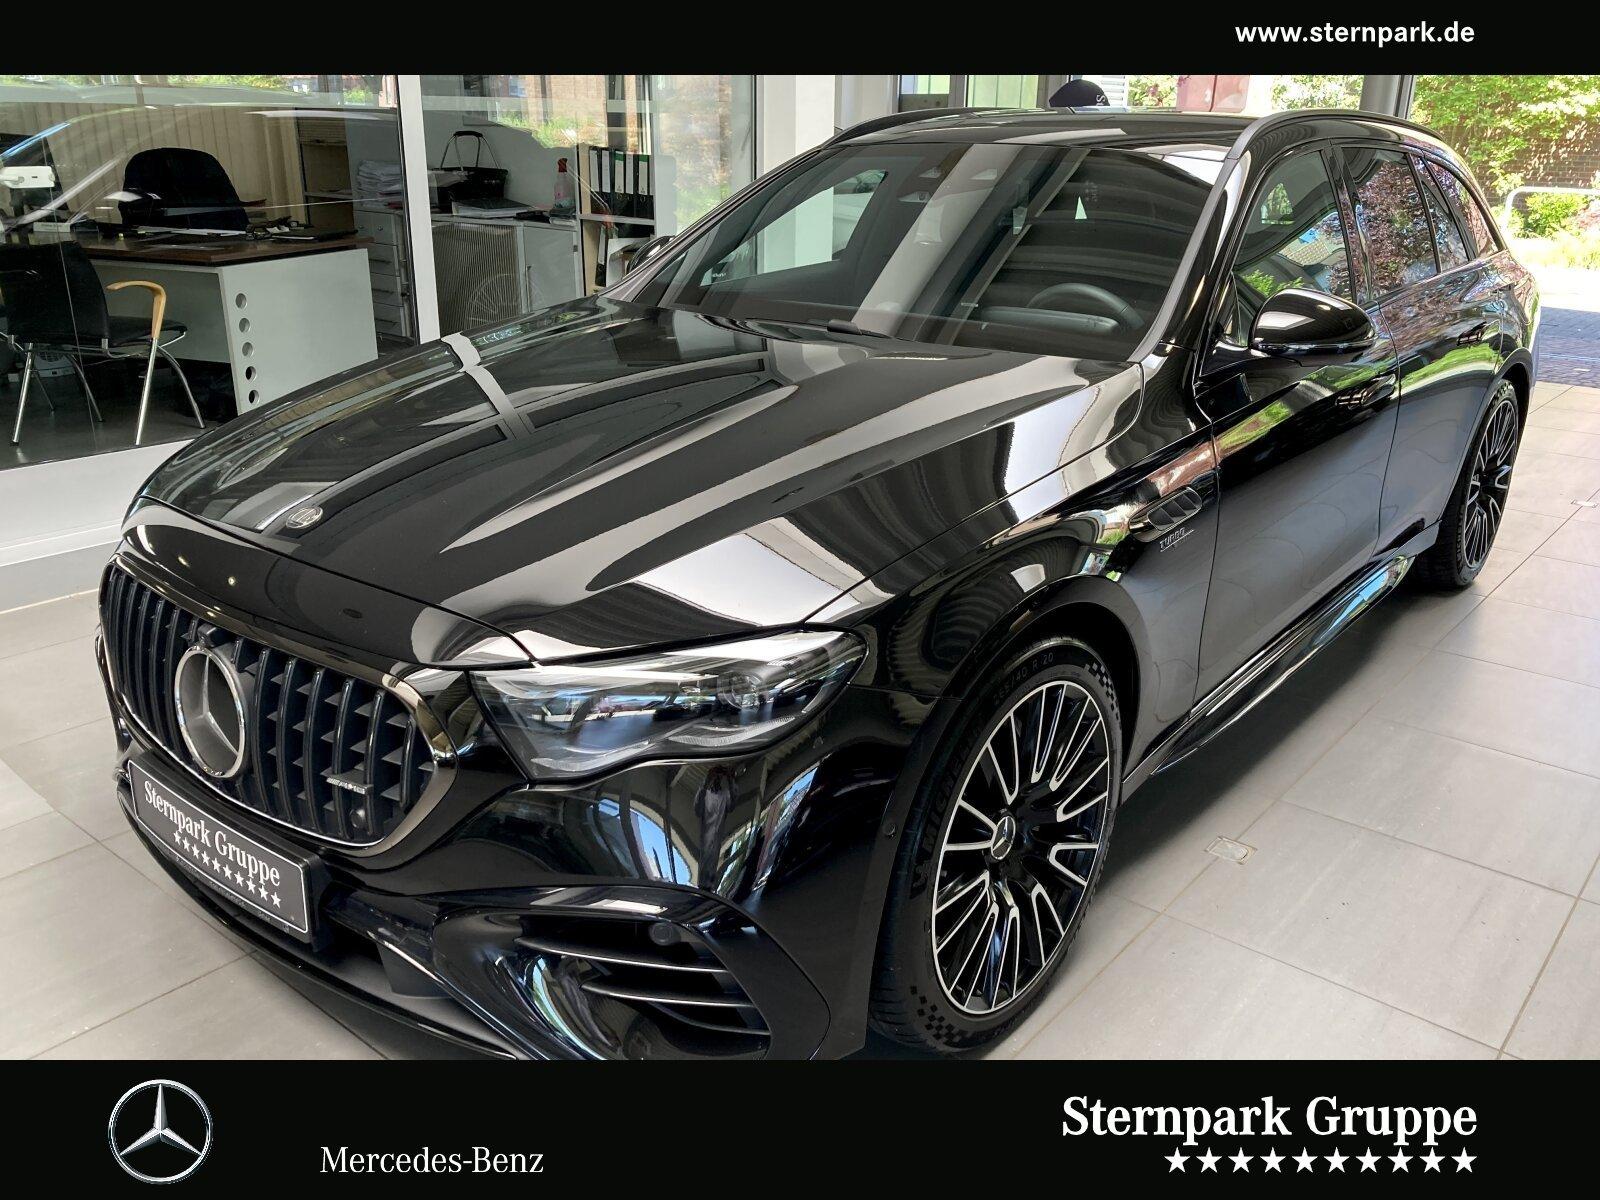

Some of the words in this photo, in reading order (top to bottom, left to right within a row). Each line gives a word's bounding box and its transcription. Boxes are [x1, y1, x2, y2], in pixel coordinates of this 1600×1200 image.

[1042, 652, 1054, 666] 20
[144, 780, 211, 848] Sternpark
[214, 830, 281, 887] Gruppe
